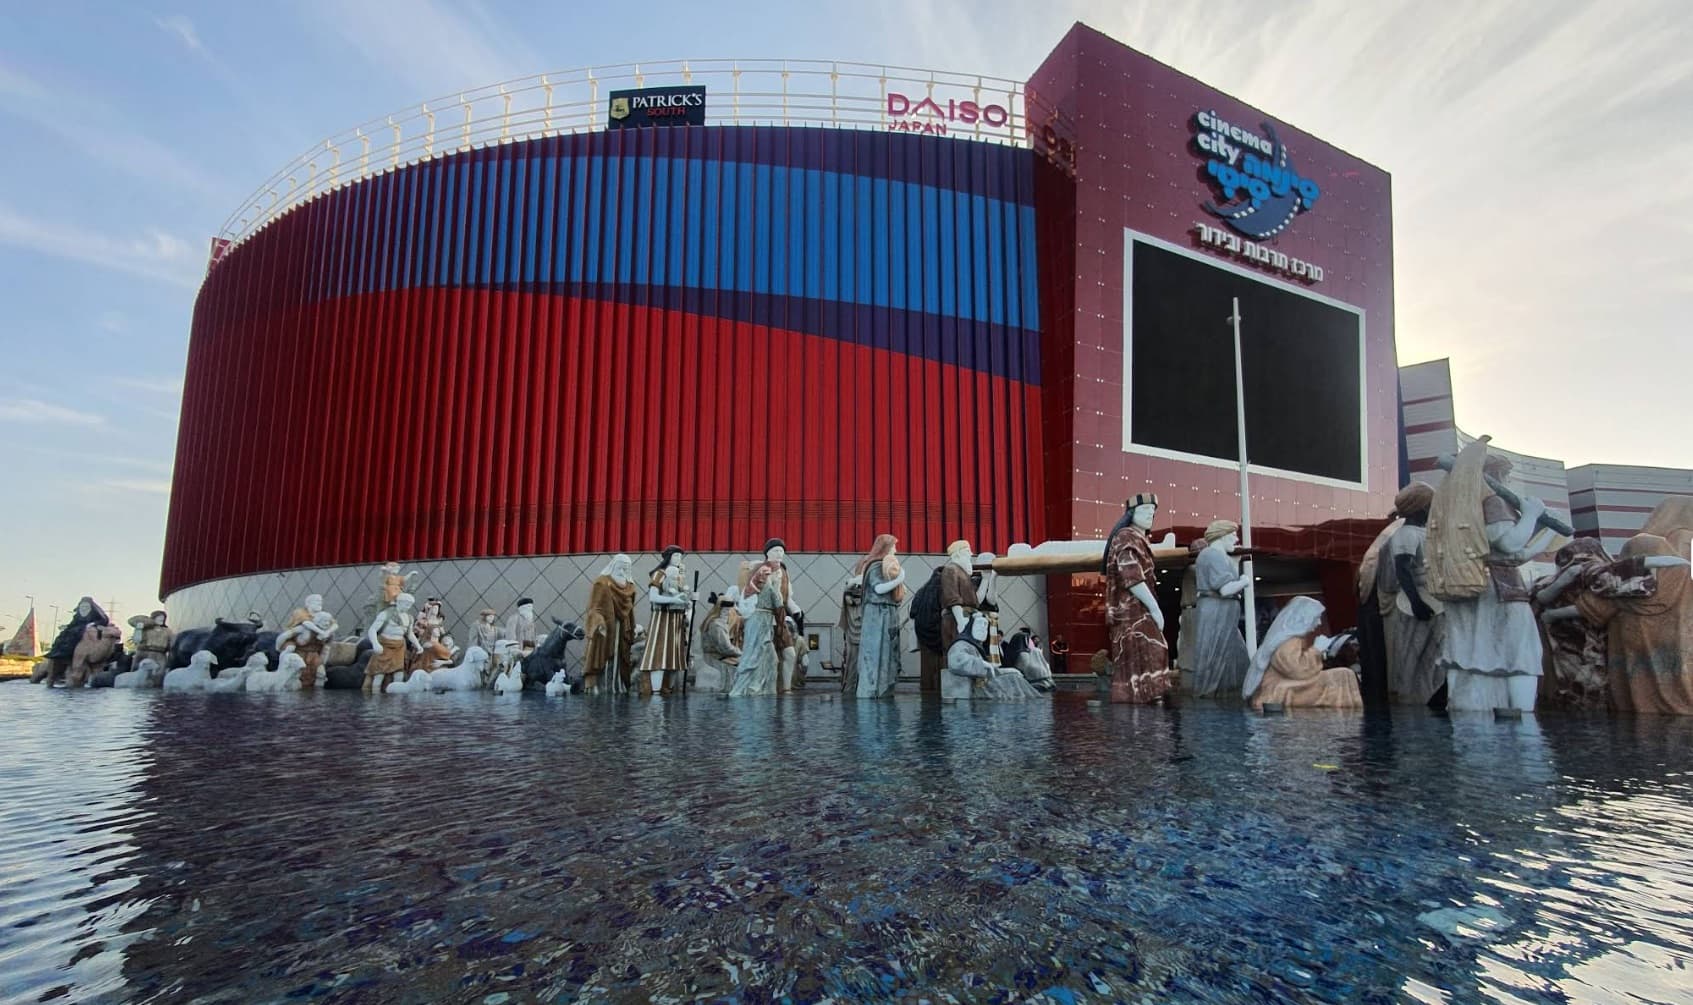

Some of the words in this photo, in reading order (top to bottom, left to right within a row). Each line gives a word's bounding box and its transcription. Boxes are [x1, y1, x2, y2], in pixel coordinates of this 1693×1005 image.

[632, 93, 702, 109] PATRICK'S
[647, 107, 686, 117] SOUTH
[887, 93, 1008, 128] DAISO
[888, 120, 947, 135] JAPAN
[1197, 110, 1273, 155] cinema
[1197, 132, 1241, 165] city
[1196, 222, 1241, 252] ובידור
[1243, 240, 1289, 270] תרבות
[1290, 257, 1324, 282] מרכז
